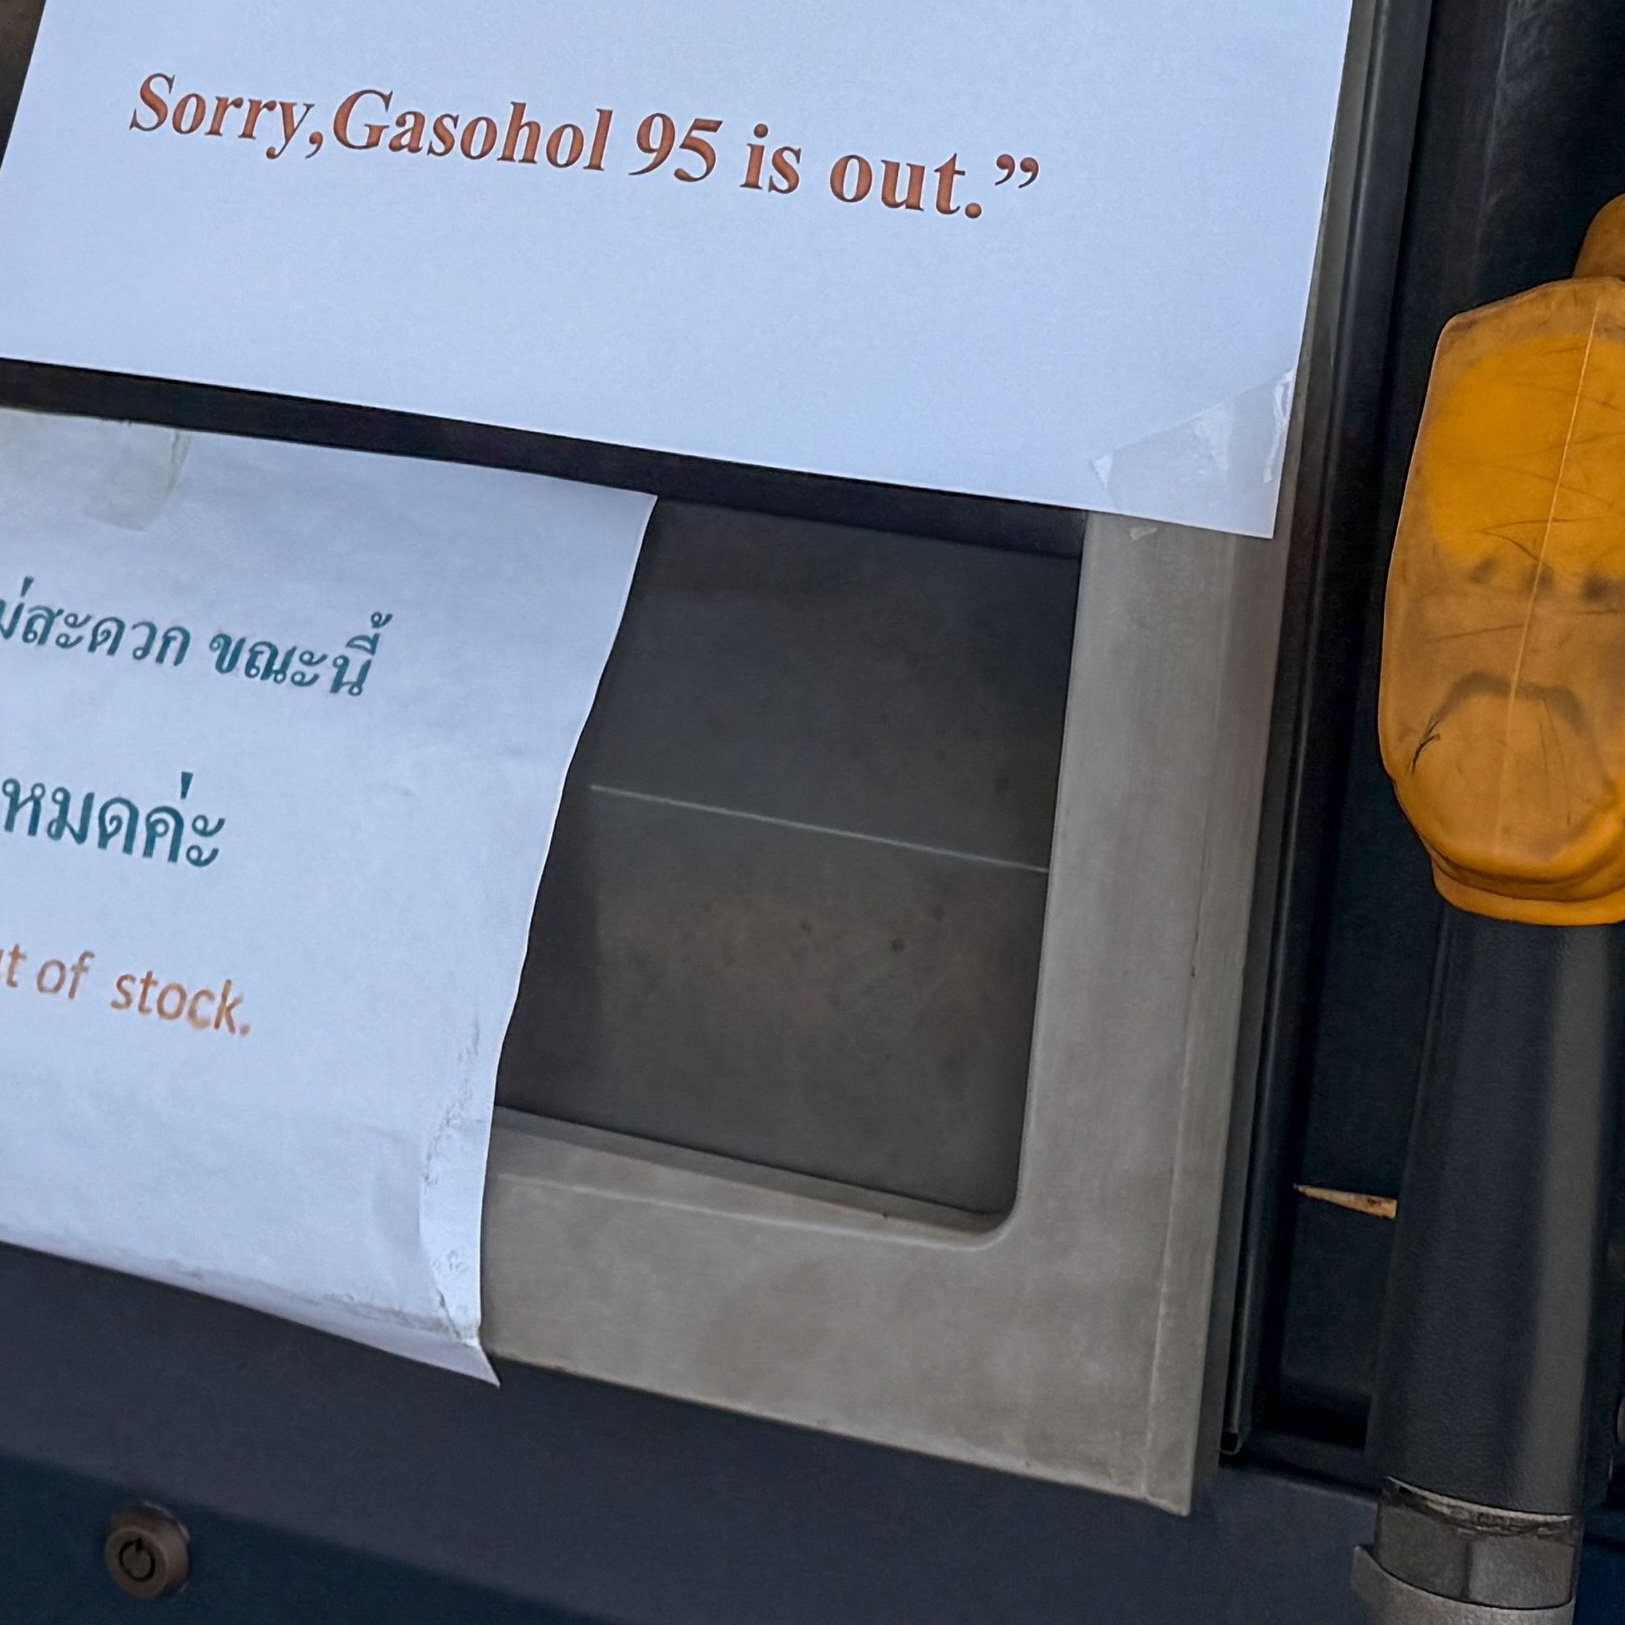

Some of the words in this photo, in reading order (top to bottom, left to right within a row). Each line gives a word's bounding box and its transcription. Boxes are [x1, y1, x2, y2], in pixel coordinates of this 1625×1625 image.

[128, 72, 612, 172] Sorry,Gasohol
[628, 111, 723, 182] 95
[739, 123, 803, 194] is
[208, 610, 394, 699] ขณะนี้
[1, 771, 227, 869] หมดค่ะ
[36, 948, 95, 1001] of
[110, 966, 253, 1038] stock.
